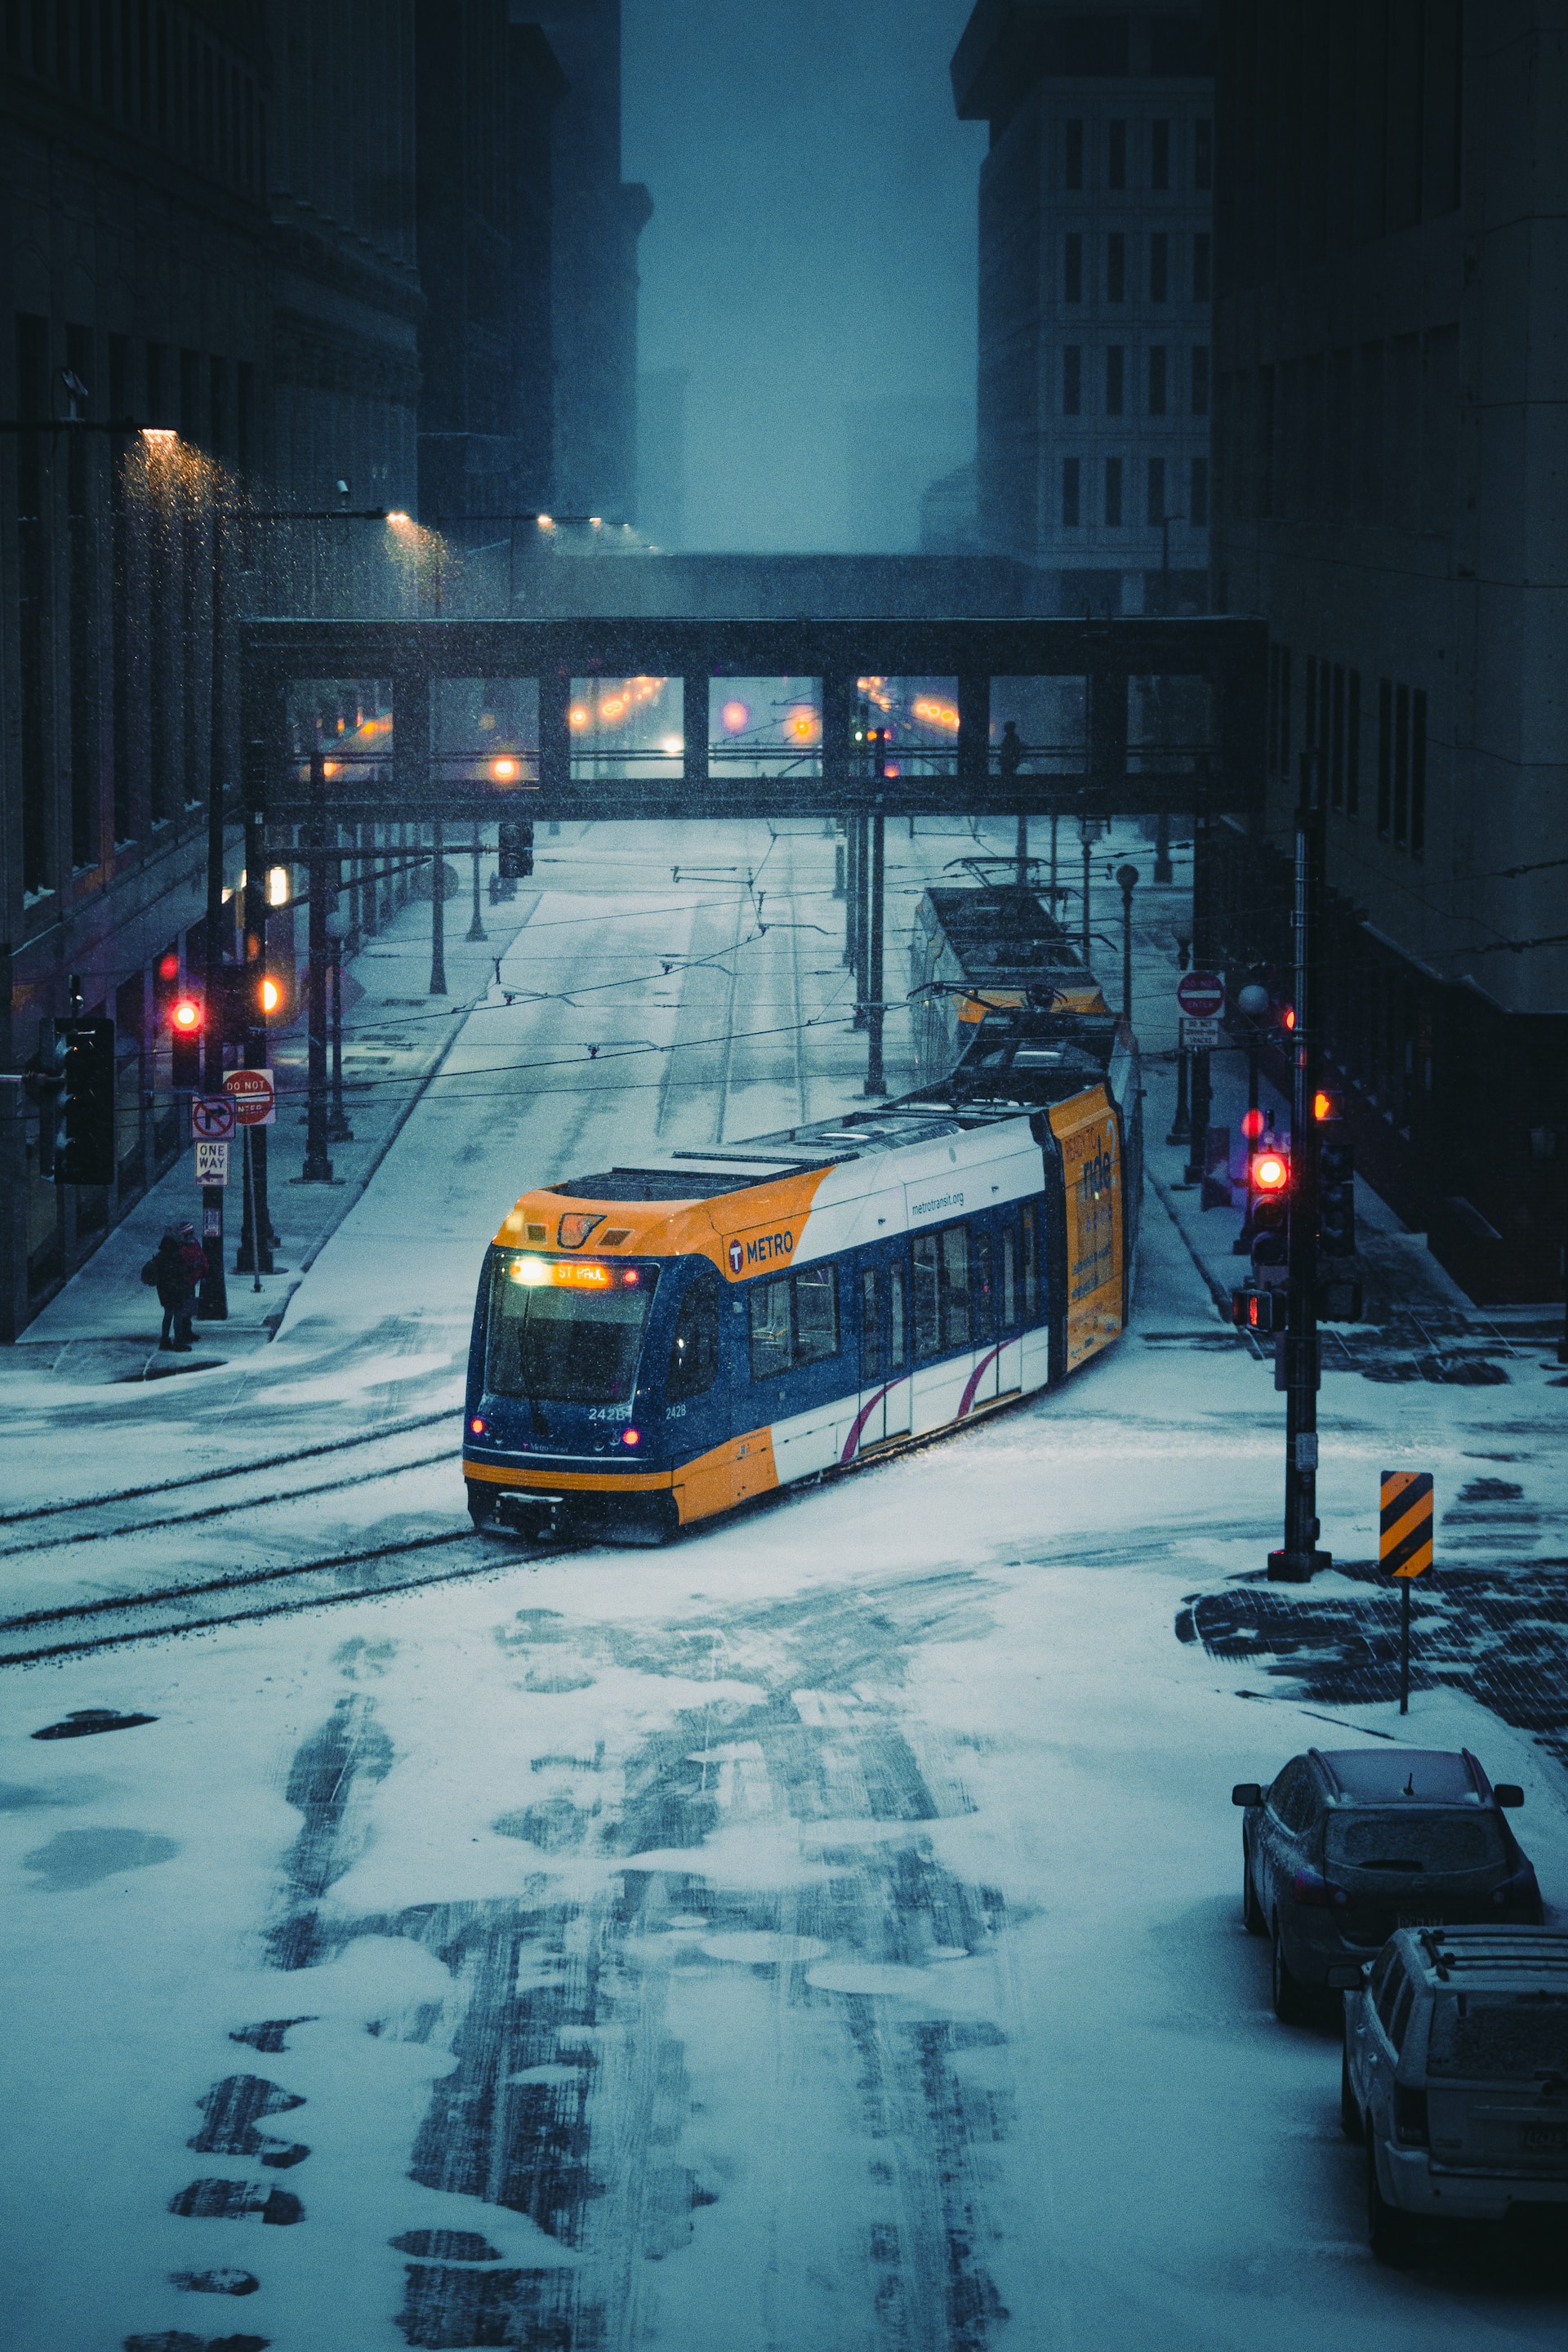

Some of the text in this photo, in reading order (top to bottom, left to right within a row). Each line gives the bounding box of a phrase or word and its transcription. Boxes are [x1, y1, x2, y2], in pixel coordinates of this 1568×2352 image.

[1188, 1000, 1214, 1009] ENTER
[226, 1080, 265, 1091] DO NOT
[238, 1104, 262, 1114] NTER
[199, 1145, 225, 1156] ONE
[199, 1158, 225, 1169] WAY
[912, 1192, 964, 1214] metrotransit.org
[746, 1230, 793, 1264] METRO
[577, 1267, 605, 1281] PAUL
